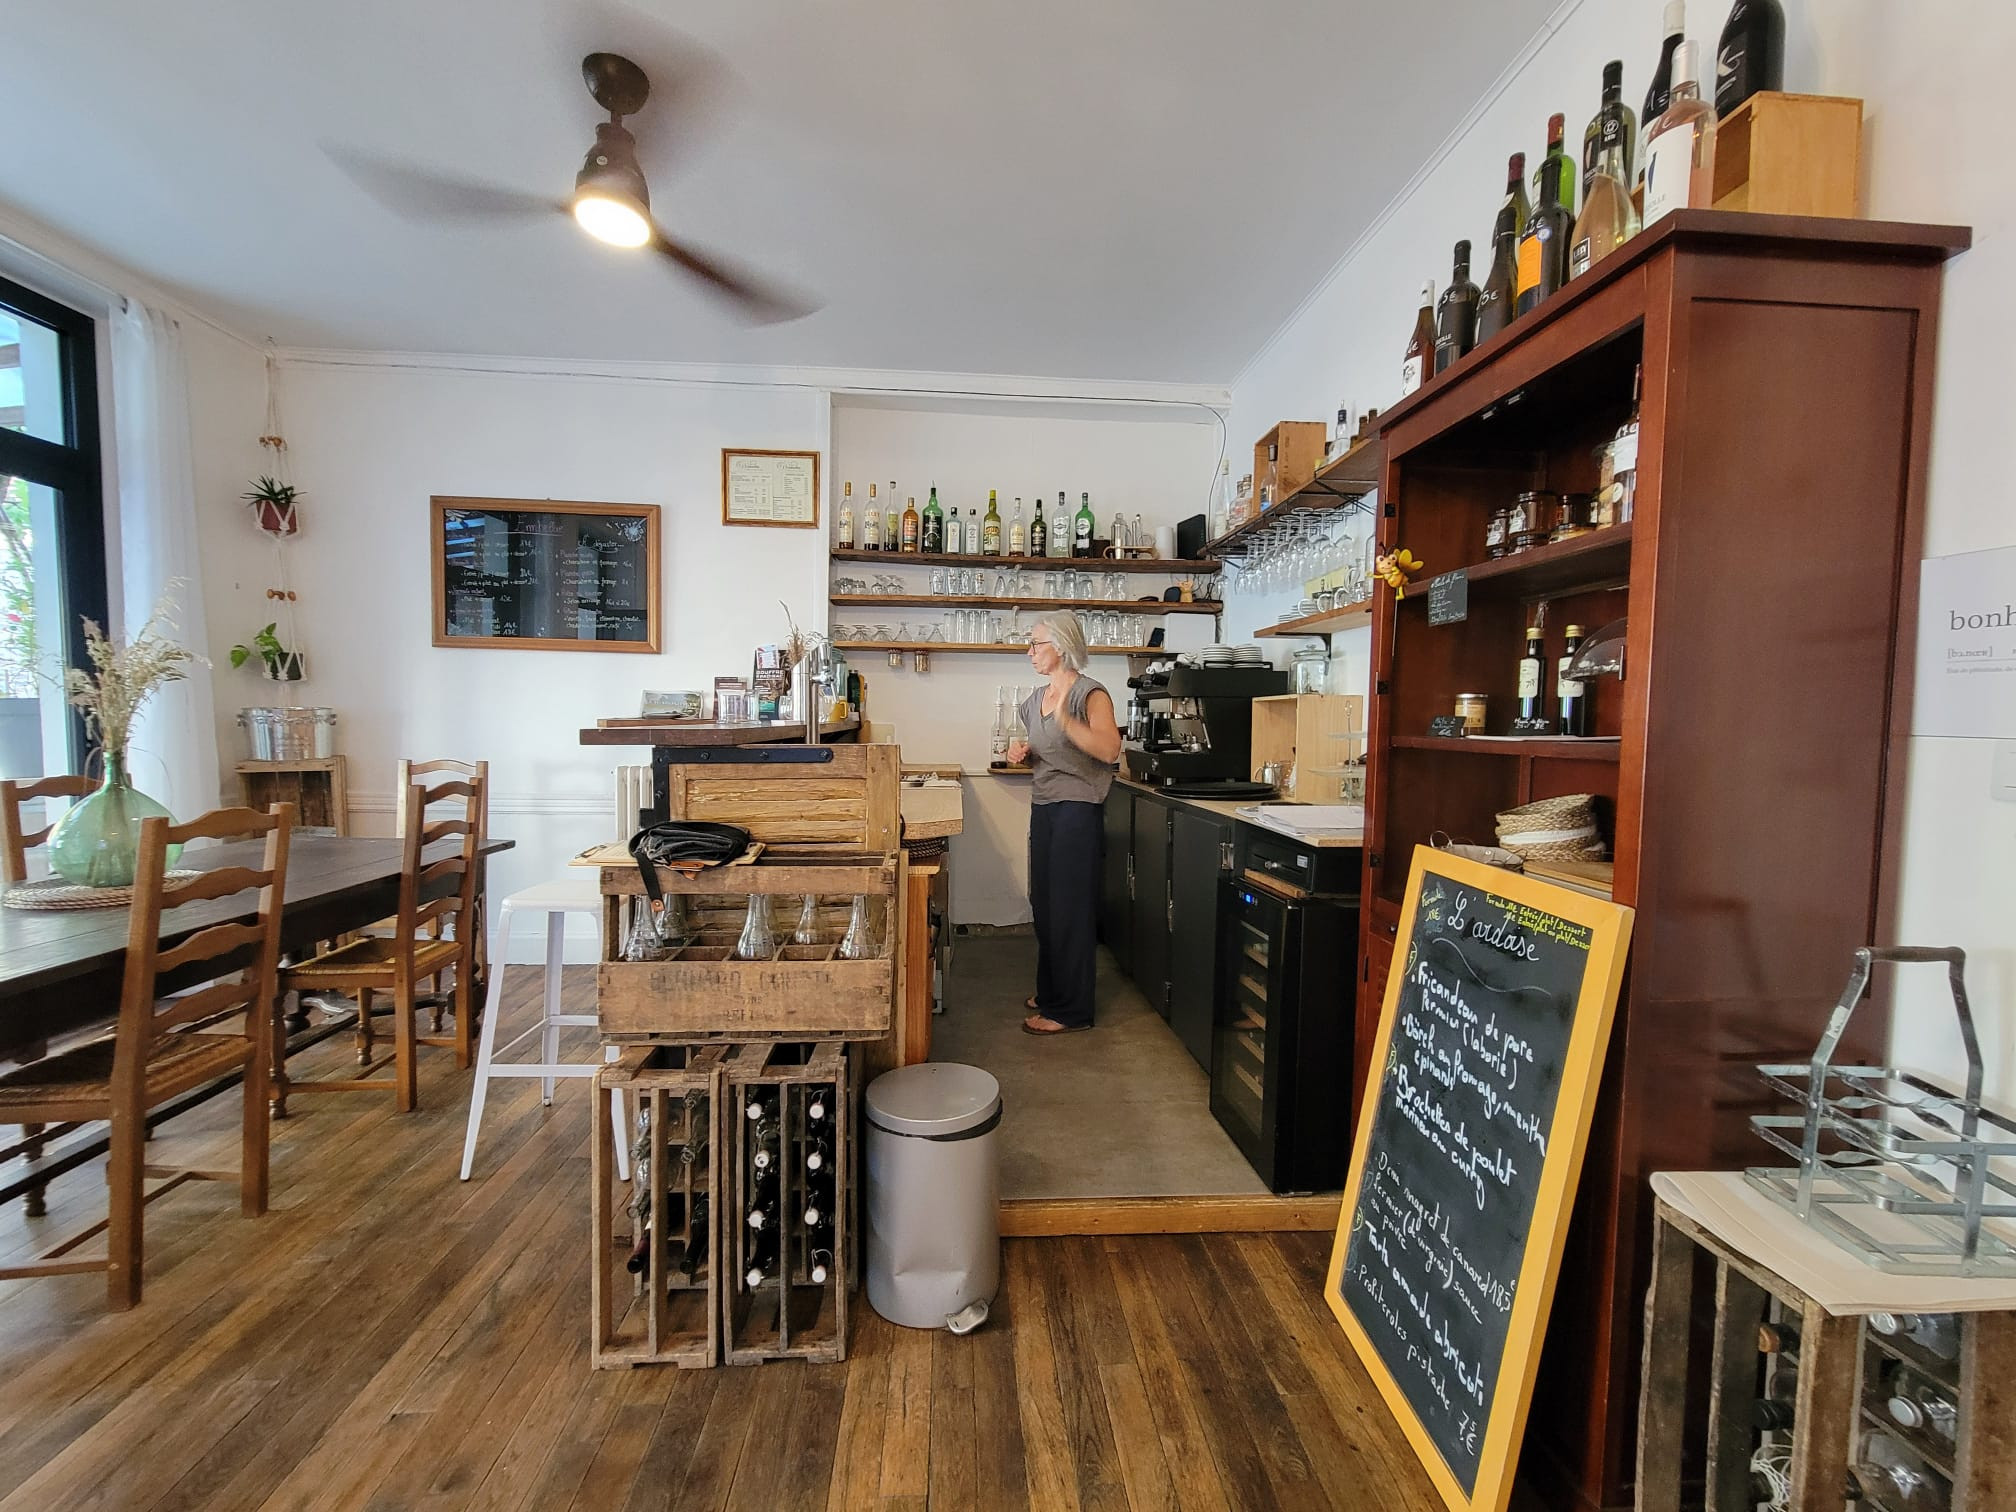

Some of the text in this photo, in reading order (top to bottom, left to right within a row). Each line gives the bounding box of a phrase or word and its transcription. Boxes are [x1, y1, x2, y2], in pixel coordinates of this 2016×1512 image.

[1451, 1151, 1485, 1211] curry
[1454, 1122, 1469, 1152] de
[1470, 1146, 1518, 1187] poulet
[1382, 1214, 1407, 1250] poivre
[1403, 1187, 1441, 1232] magret
[1452, 1246, 1491, 1298] canard
[1406, 1344, 1451, 1411] pistache
